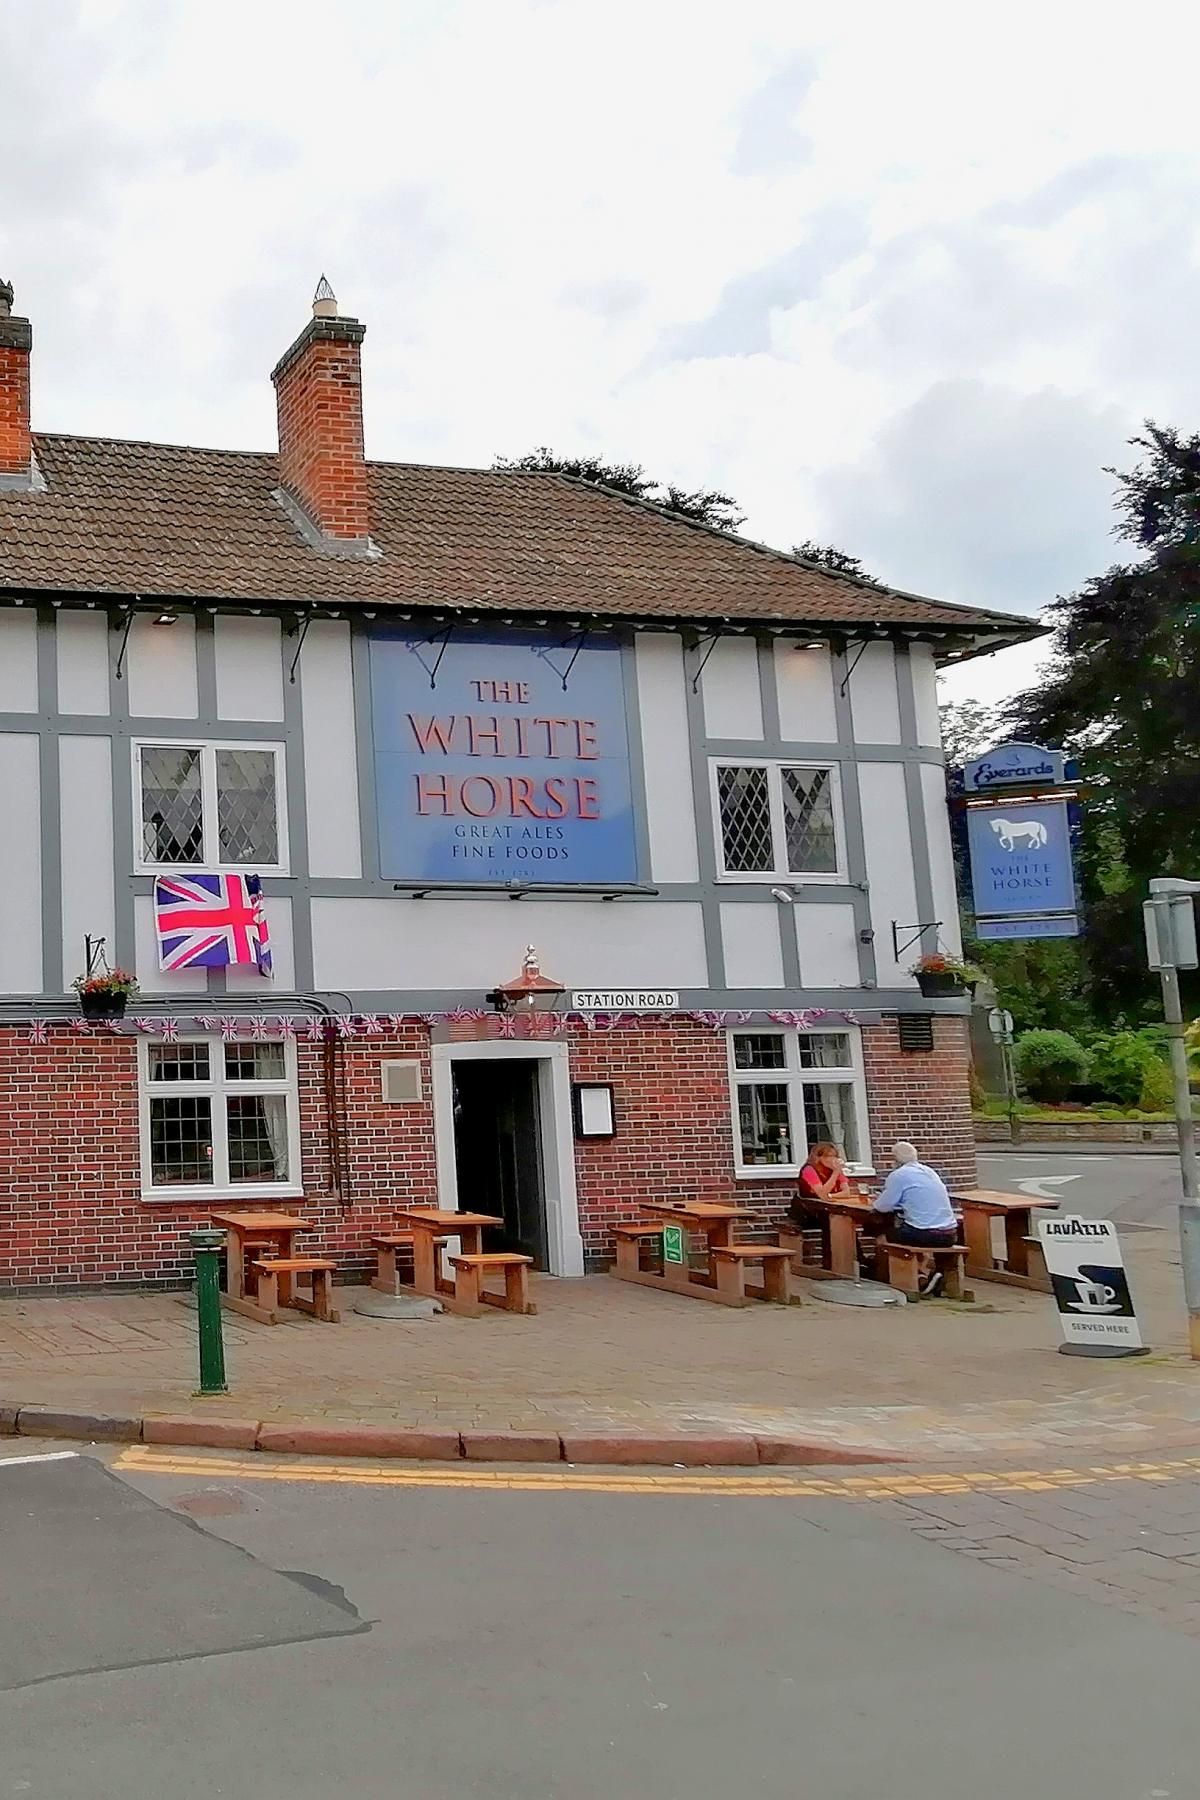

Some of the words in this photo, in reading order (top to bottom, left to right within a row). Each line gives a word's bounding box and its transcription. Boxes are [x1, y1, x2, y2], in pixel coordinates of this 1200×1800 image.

[470, 680, 530, 704] THE
[405, 713, 599, 760] WHITE
[974, 762, 1054, 783] Everards
[412, 774, 600, 820] HORSE
[455, 824, 513, 839] GREAT
[522, 826, 564, 840] ALES
[452, 845, 496, 858] FINE
[506, 846, 569, 860] FOODS
[990, 863, 1052, 876] WHITE
[993, 877, 1053, 890] HORSE
[577, 994, 634, 1007] STATION
[638, 994, 674, 1006] ROAD
[1046, 1220, 1110, 1236] LAVAZZA
[1071, 1322, 1105, 1332] SERVED
[1106, 1324, 1129, 1334] HERE
